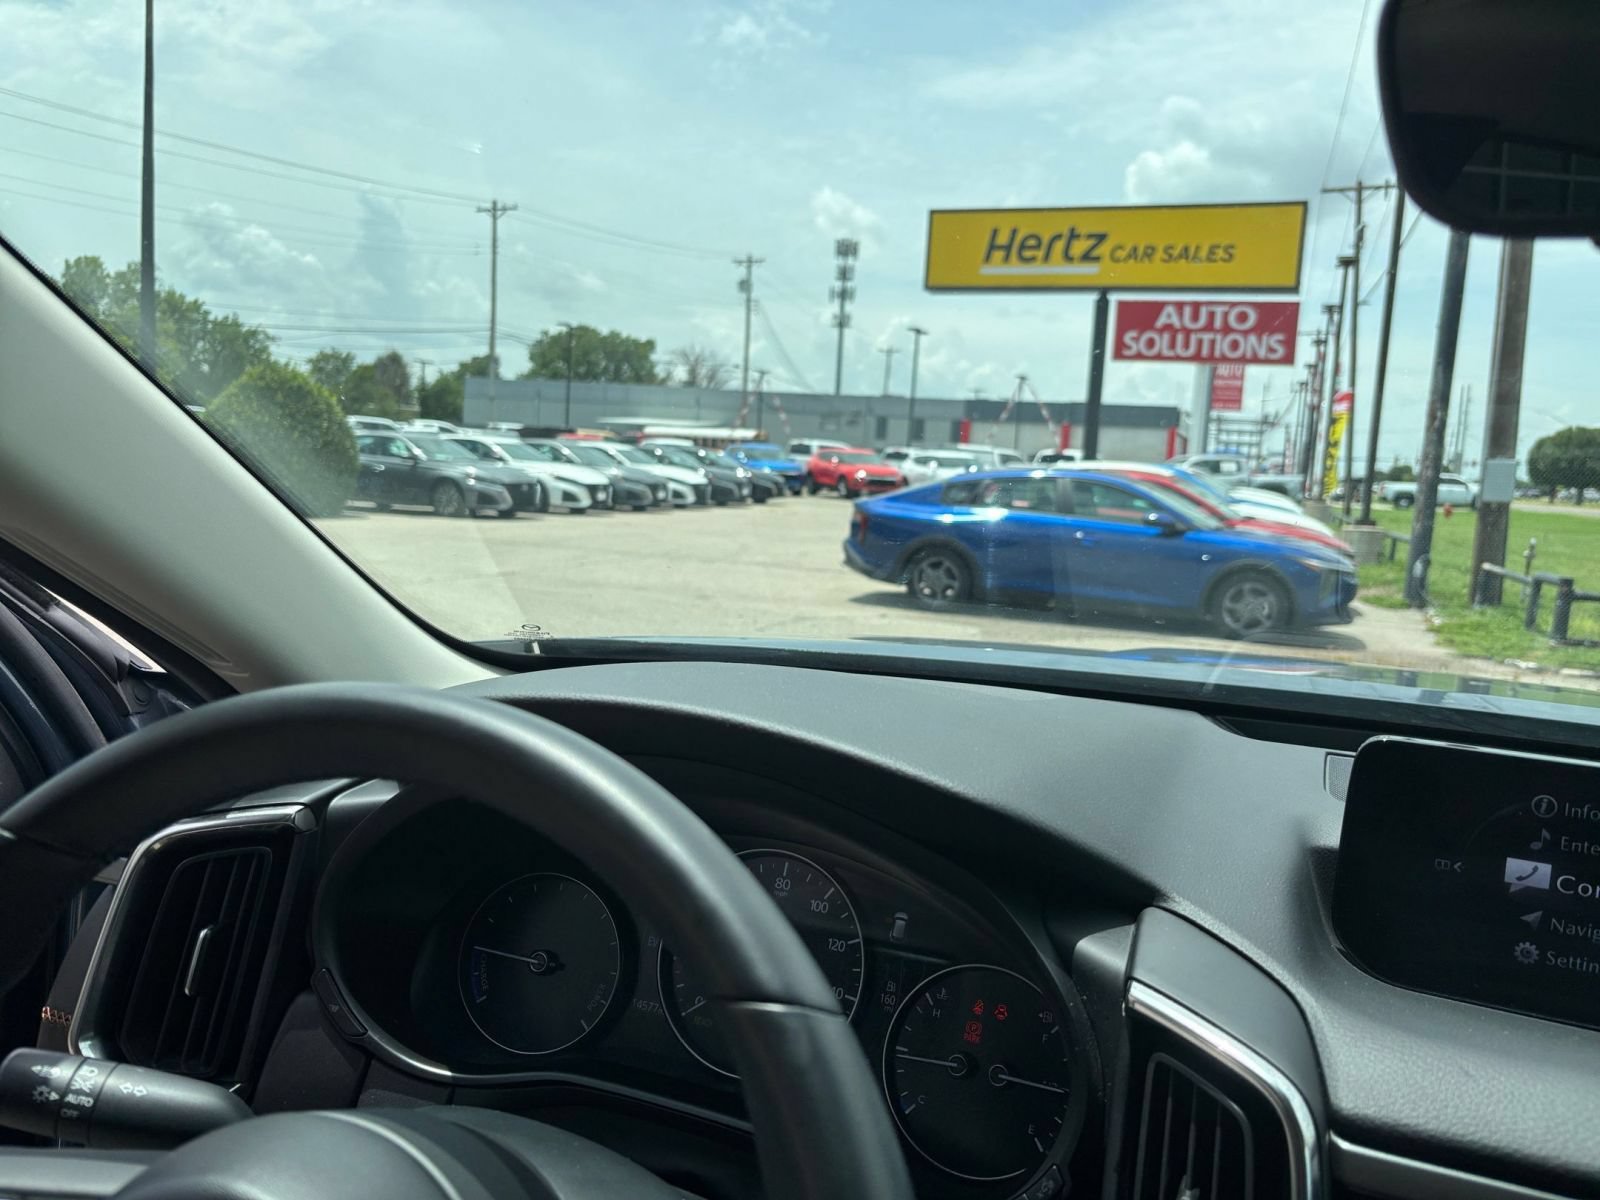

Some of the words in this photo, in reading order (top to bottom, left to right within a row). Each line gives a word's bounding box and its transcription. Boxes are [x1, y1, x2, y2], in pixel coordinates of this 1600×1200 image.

[983, 224, 1109, 263] Hertz
[1109, 244, 1158, 264] CAR
[1160, 243, 1237, 264] SALES
[1154, 304, 1257, 330] AUTO
[1121, 329, 1286, 360] SOLUTIONS
[775, 877, 791, 890] 80
[1556, 875, 1600, 898] Co
[810, 899, 829, 913] 100
[828, 937, 846, 952] 120
[932, 1008, 941, 1018] H
[64, 1093, 94, 1107] AUTO
